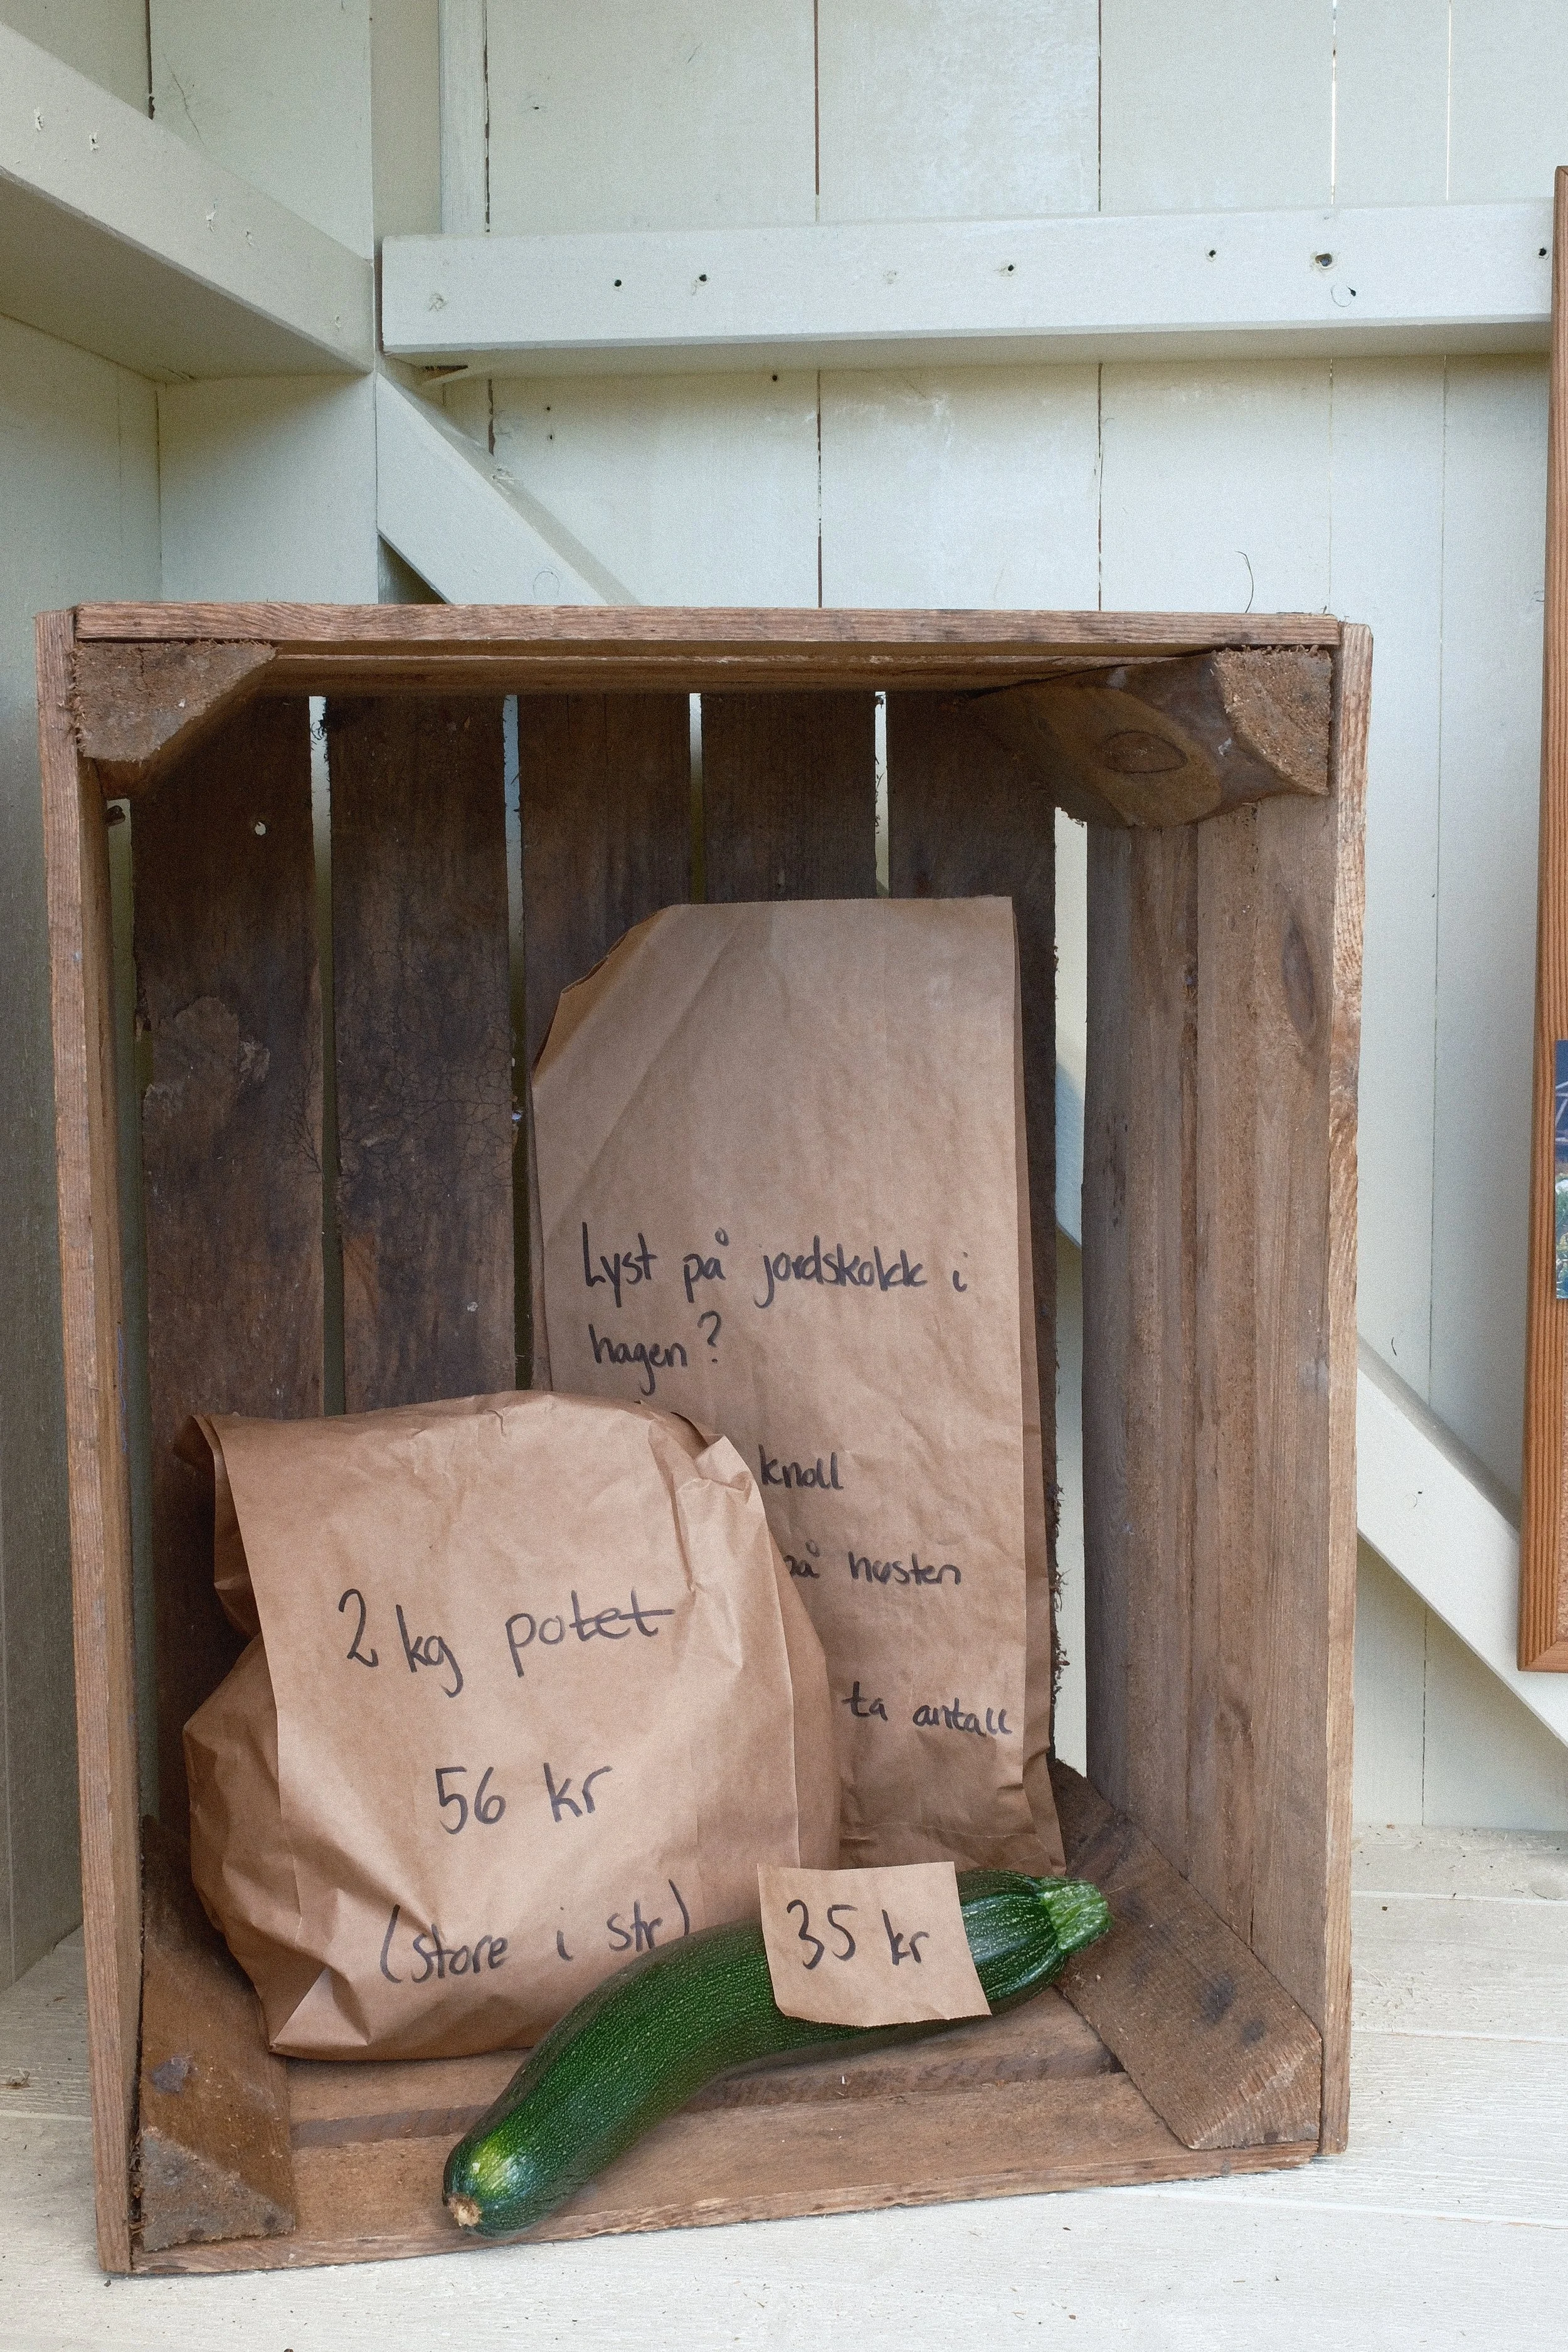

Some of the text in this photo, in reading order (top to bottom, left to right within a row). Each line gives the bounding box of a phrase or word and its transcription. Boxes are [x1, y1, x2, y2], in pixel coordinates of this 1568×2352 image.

[581, 1222, 657, 1308] Lyst
[683, 1227, 729, 1303] på
[953, 1251, 968, 1293] i
[758, 1444, 844, 1490] knoll
[338, 1587, 675, 1698] 2 kg potet
[913, 1697, 1013, 1737] antall
[435, 1762, 613, 1835] 56 kr
[379, 1878, 690, 1984] (store i str)
[787, 1899, 930, 1970] 35 kr
